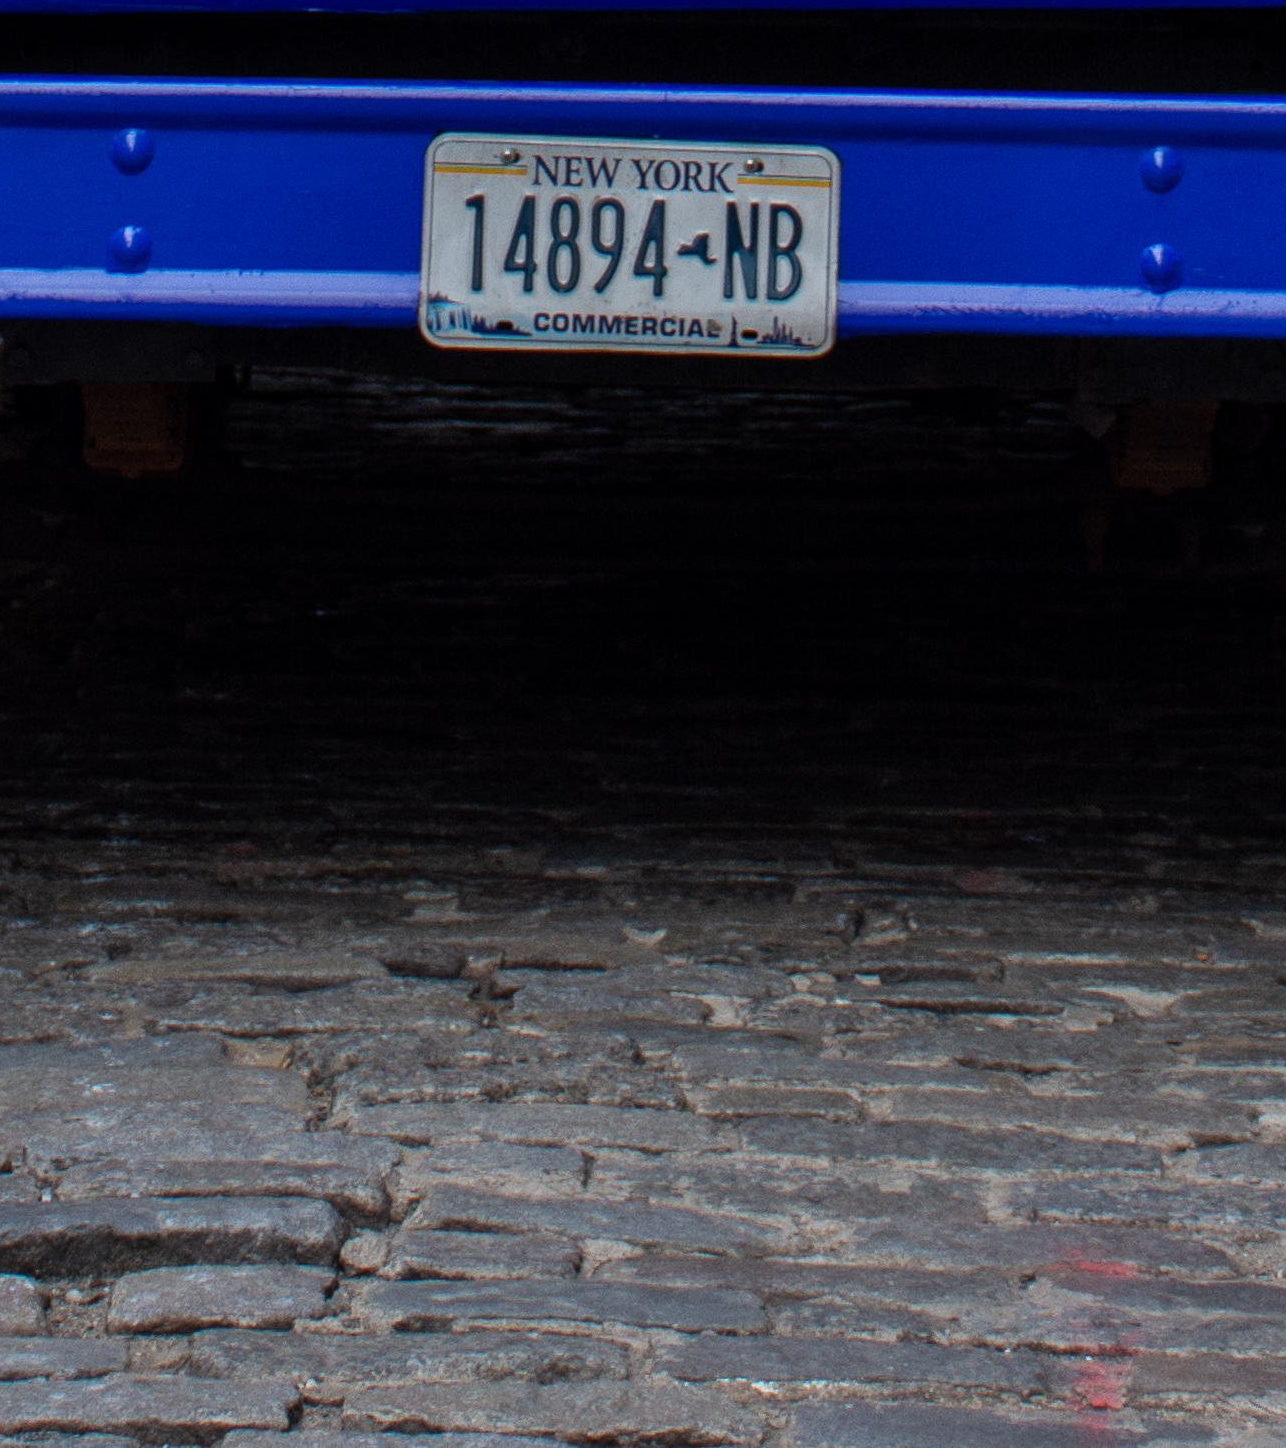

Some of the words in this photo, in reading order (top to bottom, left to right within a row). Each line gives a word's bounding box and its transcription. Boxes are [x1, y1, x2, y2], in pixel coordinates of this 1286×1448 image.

[531, 154, 622, 188] NEW
[631, 157, 734, 194] YORK
[465, 193, 668, 298] 14894
[722, 199, 804, 302] NB
[533, 311, 721, 339] COMMERCIAL
